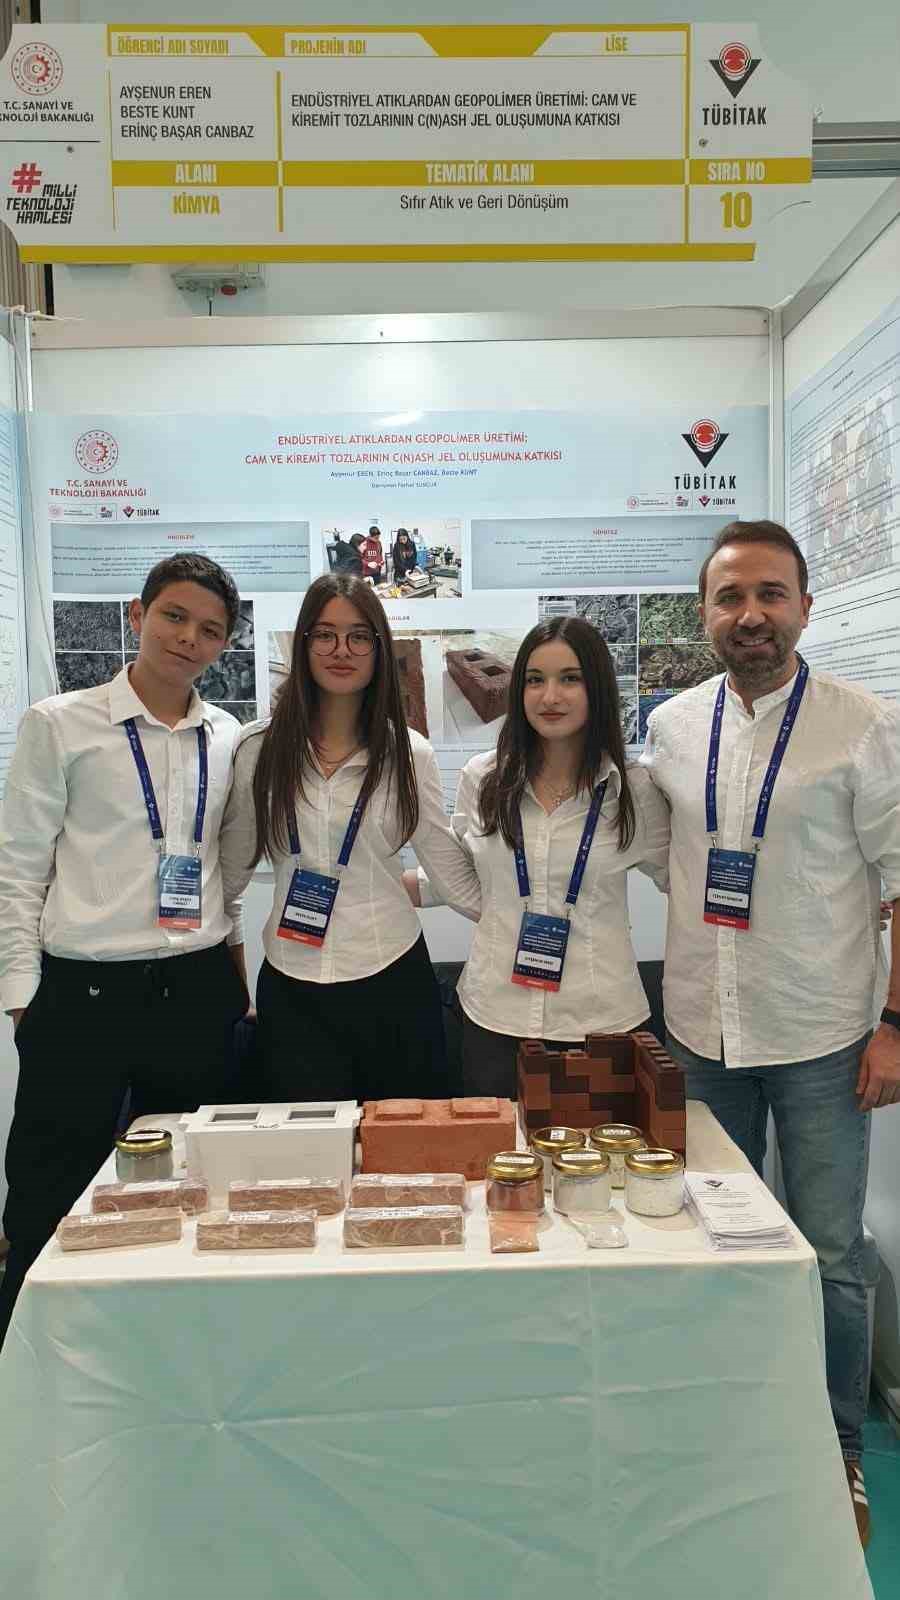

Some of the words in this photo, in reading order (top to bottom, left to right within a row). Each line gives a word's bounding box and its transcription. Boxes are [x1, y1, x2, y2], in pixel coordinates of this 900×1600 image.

[117, 36, 164, 54] ÖĞRENCİ
[168, 39, 186, 54] ADI
[190, 39, 229, 54] SOYADI
[291, 37, 345, 54] PROJENİN
[348, 40, 368, 54] ADI
[605, 35, 629, 52] LİSE
[120, 86, 175, 102] AYŞENUR
[179, 86, 212, 99] EREN
[291, 92, 373, 107] ENDÜSTRİYEL
[376, 94, 450, 107] ATIKLARDAN
[454, 91, 532, 107] GEOPOLİMER
[535, 91, 588, 107] ÜRETİMİ:
[591, 94, 618, 106] CAM
[621, 94, 637, 106] VE
[4, 101, 21, 110] T.C.
[23, 100, 59, 110] SANAYİ
[60, 102, 73, 110] VE
[120, 106, 159, 118] BESTE
[162, 106, 195, 118] KUNT
[41, 112, 94, 122] BAKANLIĞI
[292, 111, 341, 127] KİREMİT
[344, 114, 413, 127] TOZLARININ
[417, 113, 466, 129] C(N)ASH
[470, 113, 491, 126] JEL
[495, 113, 572, 129] OLUŞUMUNA
[575, 113, 620, 126] KATKISI
[702, 104, 767, 126] TÜBİTAK
[121, 121, 158, 141] ERİNÇ
[161, 125, 201, 141] BAŞAR
[205, 125, 254, 138] CANBAZ
[174, 162, 217, 184] ALANI
[425, 160, 489, 183] TEMATİK
[492, 163, 535, 182] ALANI
[707, 161, 741, 181] SIRA
[745, 161, 766, 181] NO
[172, 191, 221, 215] KİMYA
[400, 194, 425, 209] Sıfır
[429, 194, 454, 209] Atık
[458, 198, 473, 209] ve
[477, 194, 503, 209] Geri
[508, 194, 569, 212] Dönüşüm
[719, 191, 753, 229] 10
[278, 434, 345, 446] ENDÜSTRİYEL
[349, 434, 412, 445] ATIKLARDAN
[415, 432, 480, 444] GEOPOLİMER
[484, 431, 528, 444] ÜRETİMİ;
[245, 454, 267, 464] CAM
[270, 454, 283, 464] VE
[286, 453, 326, 464] KİREMİT
[330, 453, 390, 464] TOZLARININ
[392, 452, 433, 464] C(N)ASH
[437, 452, 456, 462] JEL
[458, 452, 522, 464] OLUŞUMUNA
[524, 451, 562, 462] KATKISI
[66, 479, 82, 488] T.C.
[84, 479, 115, 488] SANAYİ
[116, 479, 128, 487] VE
[674, 473, 737, 490] TÜBİTAK
[49, 488, 98, 497] TEKNOLOJİ
[101, 488, 147, 497] BAKANLIĞI
